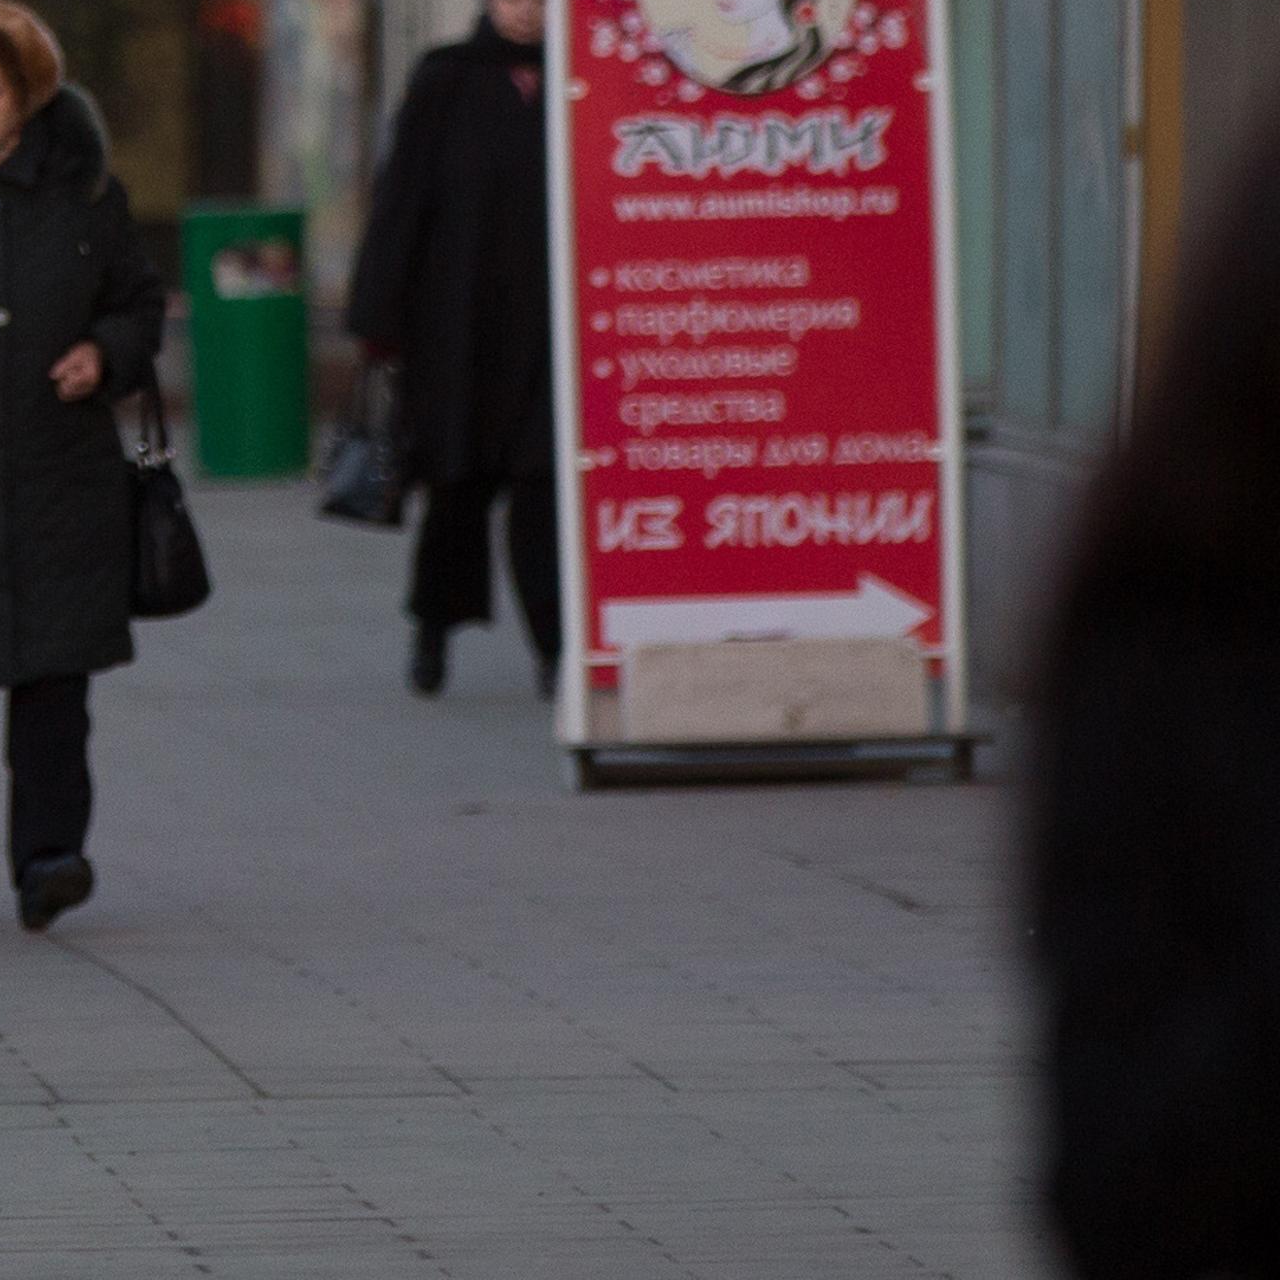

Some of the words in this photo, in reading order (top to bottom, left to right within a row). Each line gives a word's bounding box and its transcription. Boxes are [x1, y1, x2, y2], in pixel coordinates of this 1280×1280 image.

[615, 256, 809, 290] косметика
[598, 496, 684, 552] ИЗ
[705, 490, 933, 549] ЯПОНИИ
